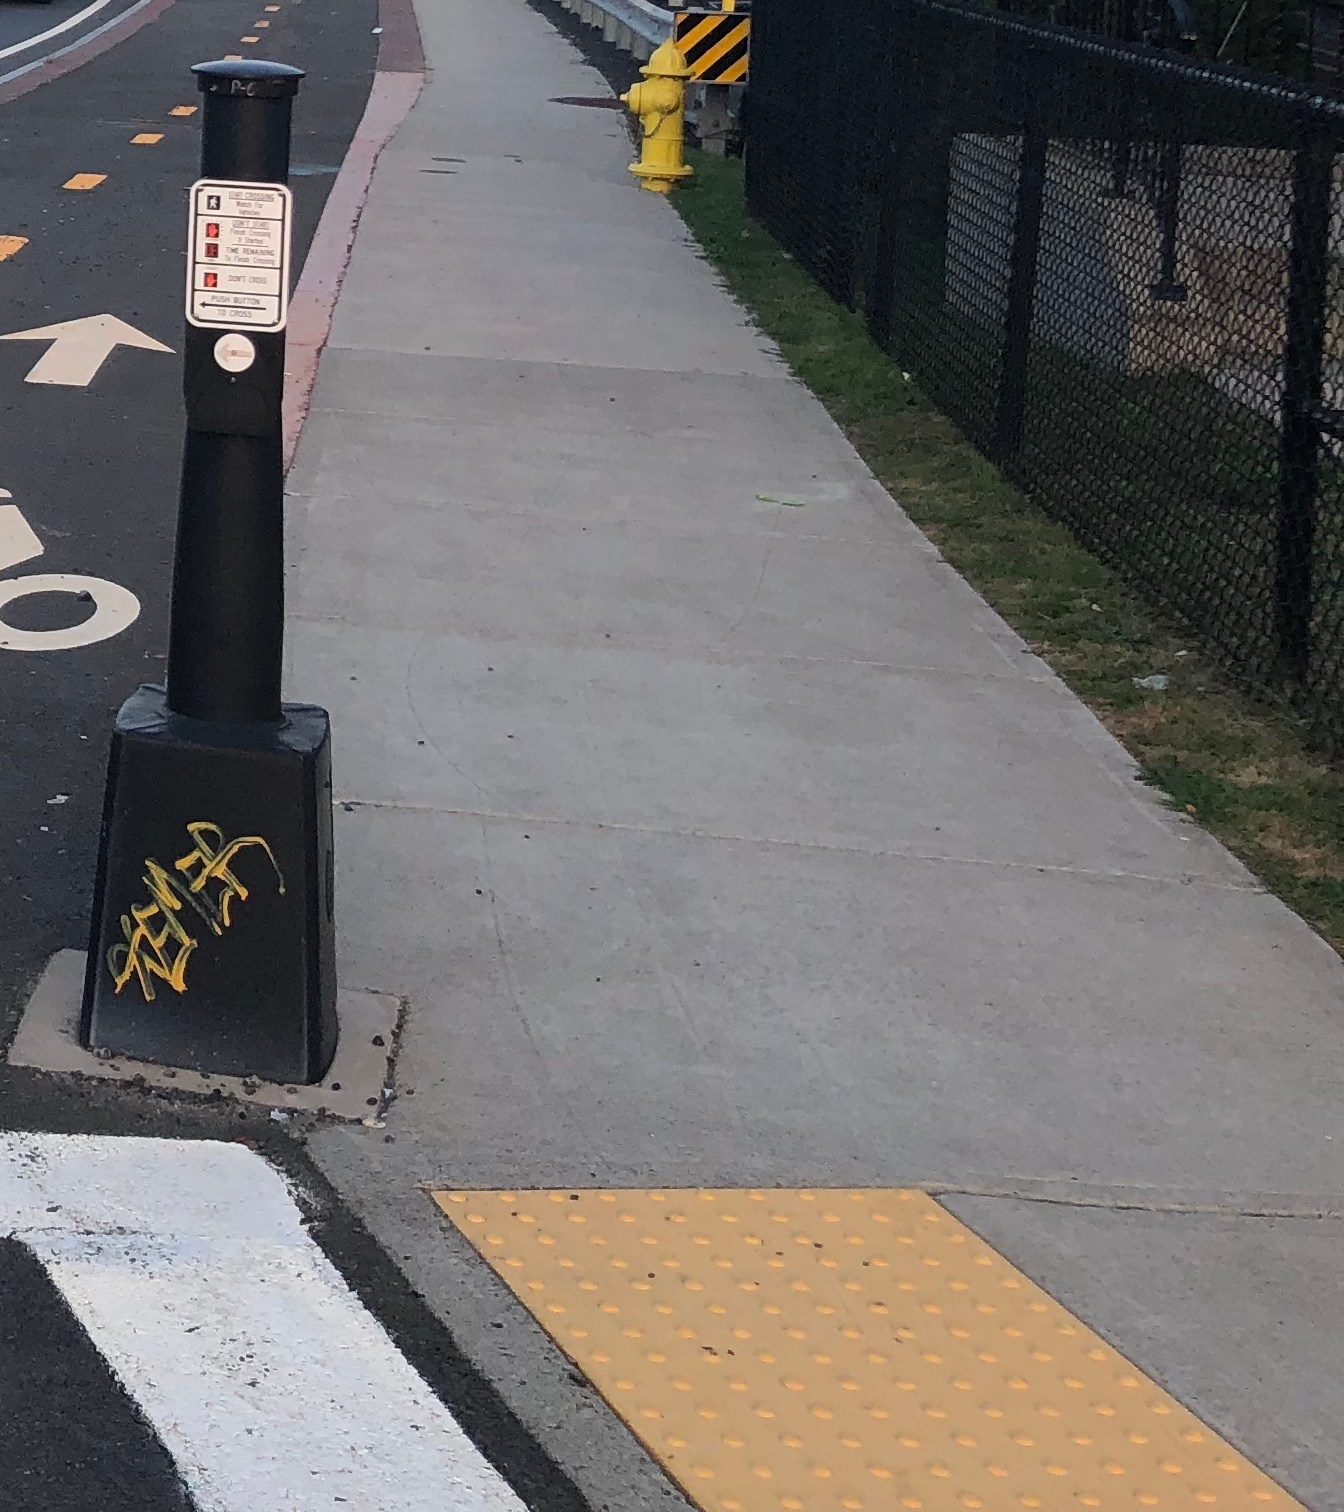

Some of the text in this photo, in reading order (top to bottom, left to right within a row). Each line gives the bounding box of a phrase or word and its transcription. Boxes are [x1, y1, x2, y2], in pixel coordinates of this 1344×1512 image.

[211, 295, 260, 305] PUSH BUTTON
[230, 309, 252, 318] CROSS
